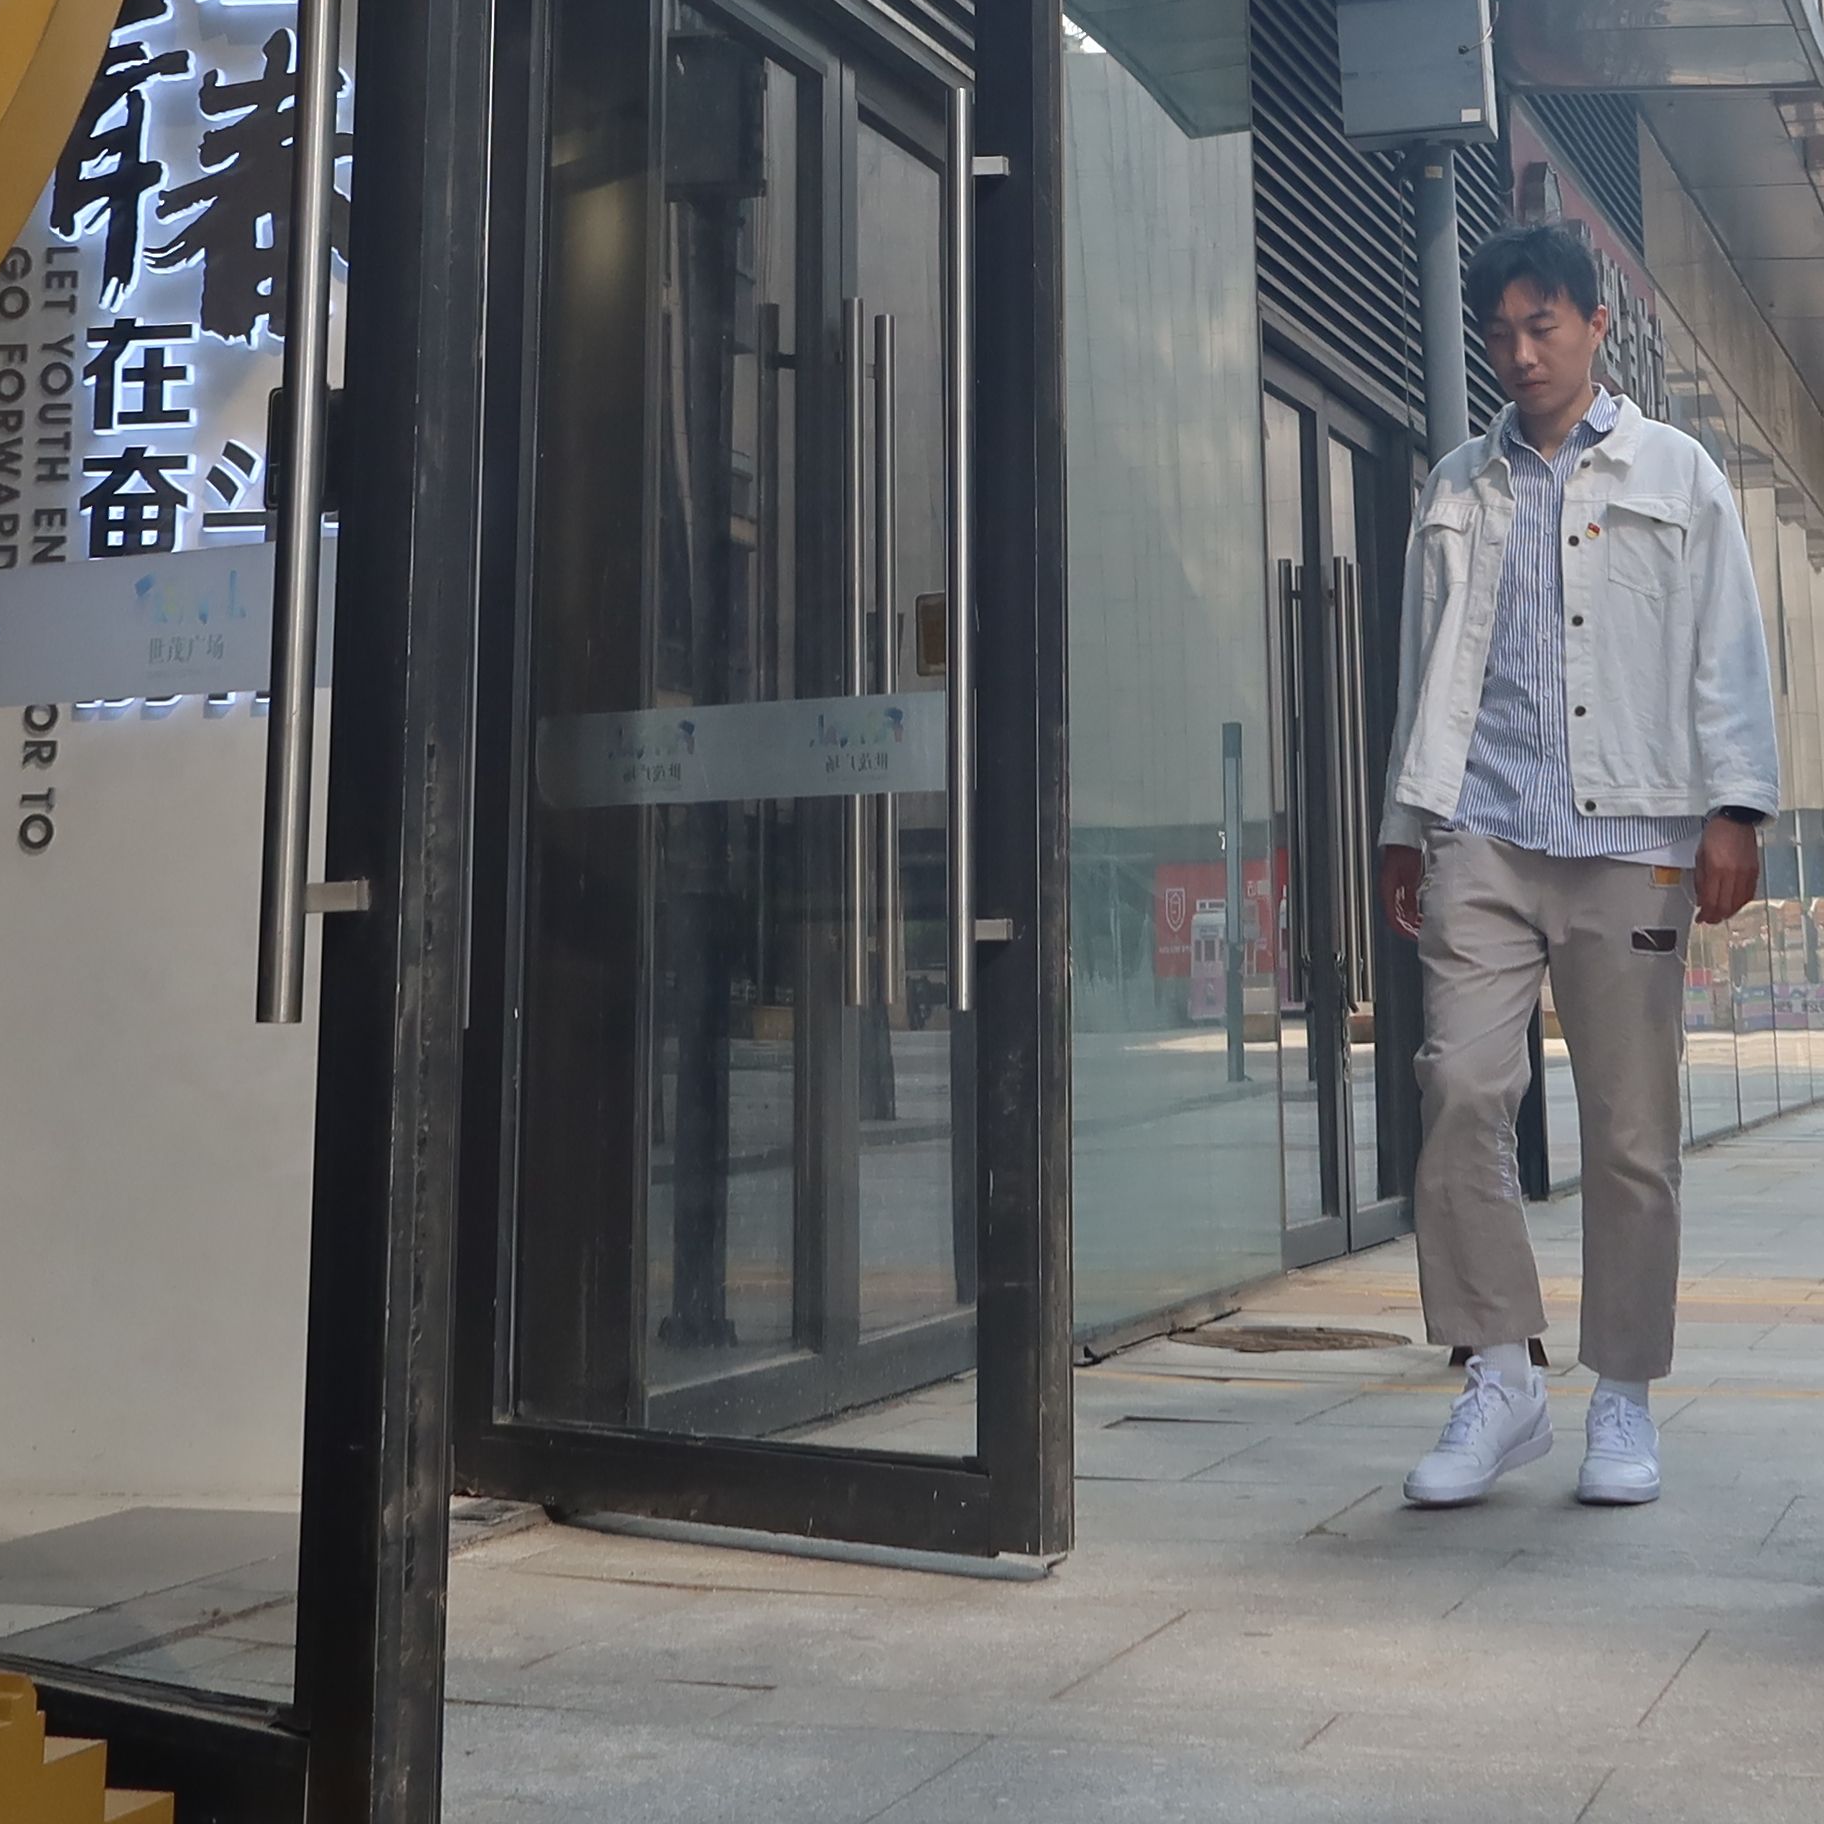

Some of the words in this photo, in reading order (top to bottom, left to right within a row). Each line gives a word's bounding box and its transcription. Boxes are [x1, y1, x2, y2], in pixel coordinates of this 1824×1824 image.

[43, 246, 80, 315] LET
[35, 333, 75, 482] YOUTH
[148, 633, 225, 665] 世茂广场
[18, 787, 56, 852] TO
